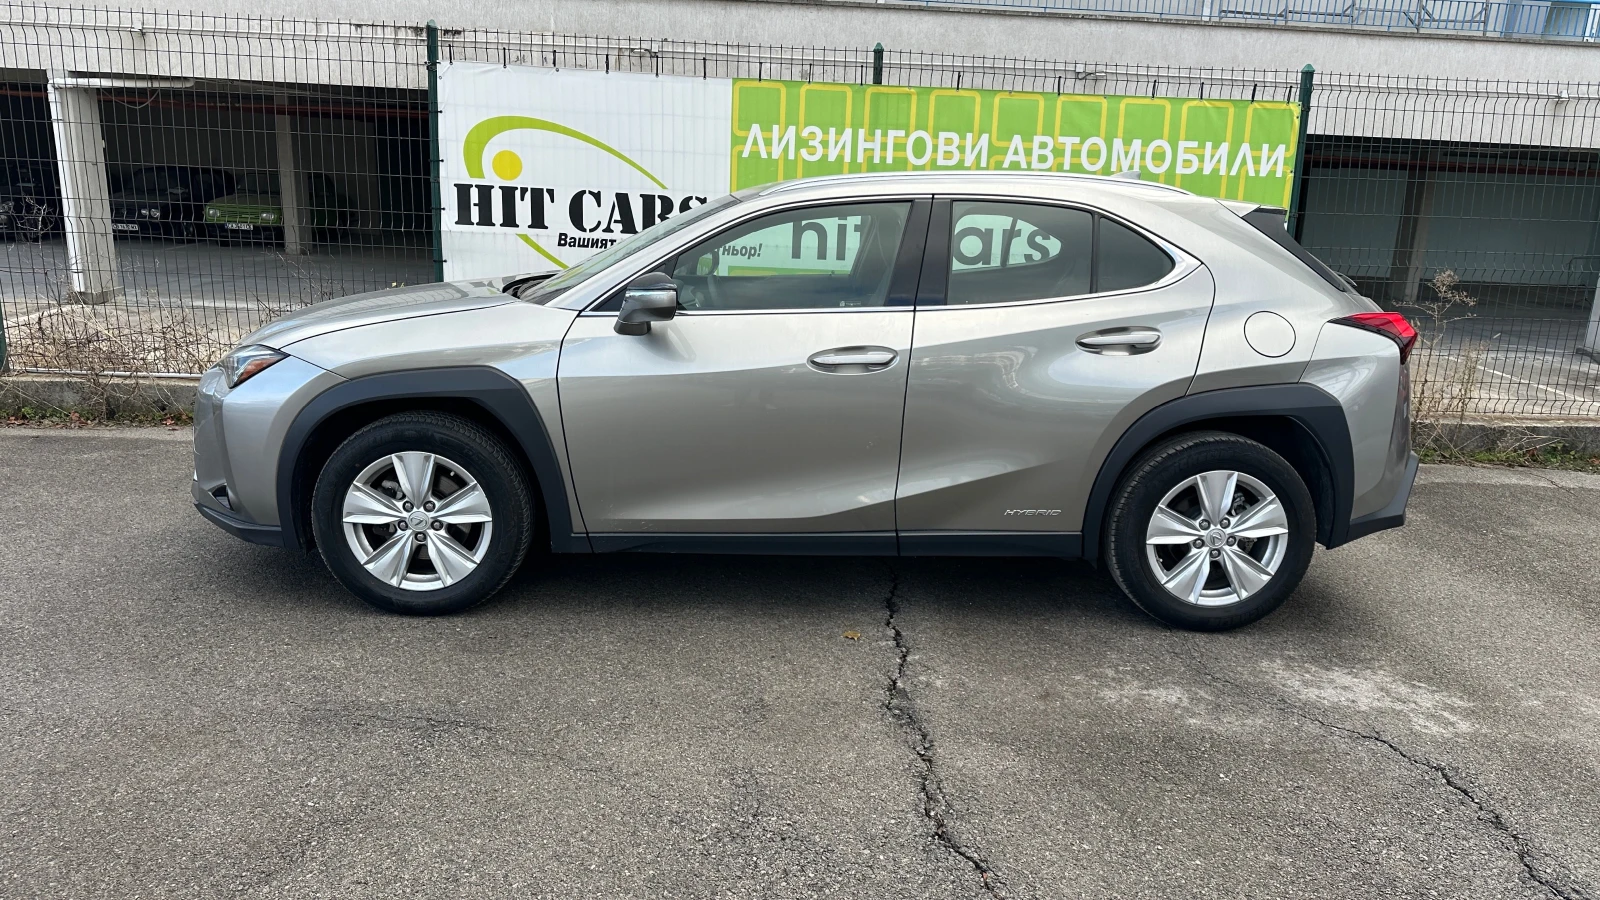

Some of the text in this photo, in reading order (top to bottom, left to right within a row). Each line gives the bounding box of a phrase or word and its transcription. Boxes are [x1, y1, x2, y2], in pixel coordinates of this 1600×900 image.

[742, 124, 1286, 177] ЛИЗИНГОВИ АВТОМОБИЛИ
[453, 183, 555, 230] HIT
[721, 243, 763, 260] ньор!
